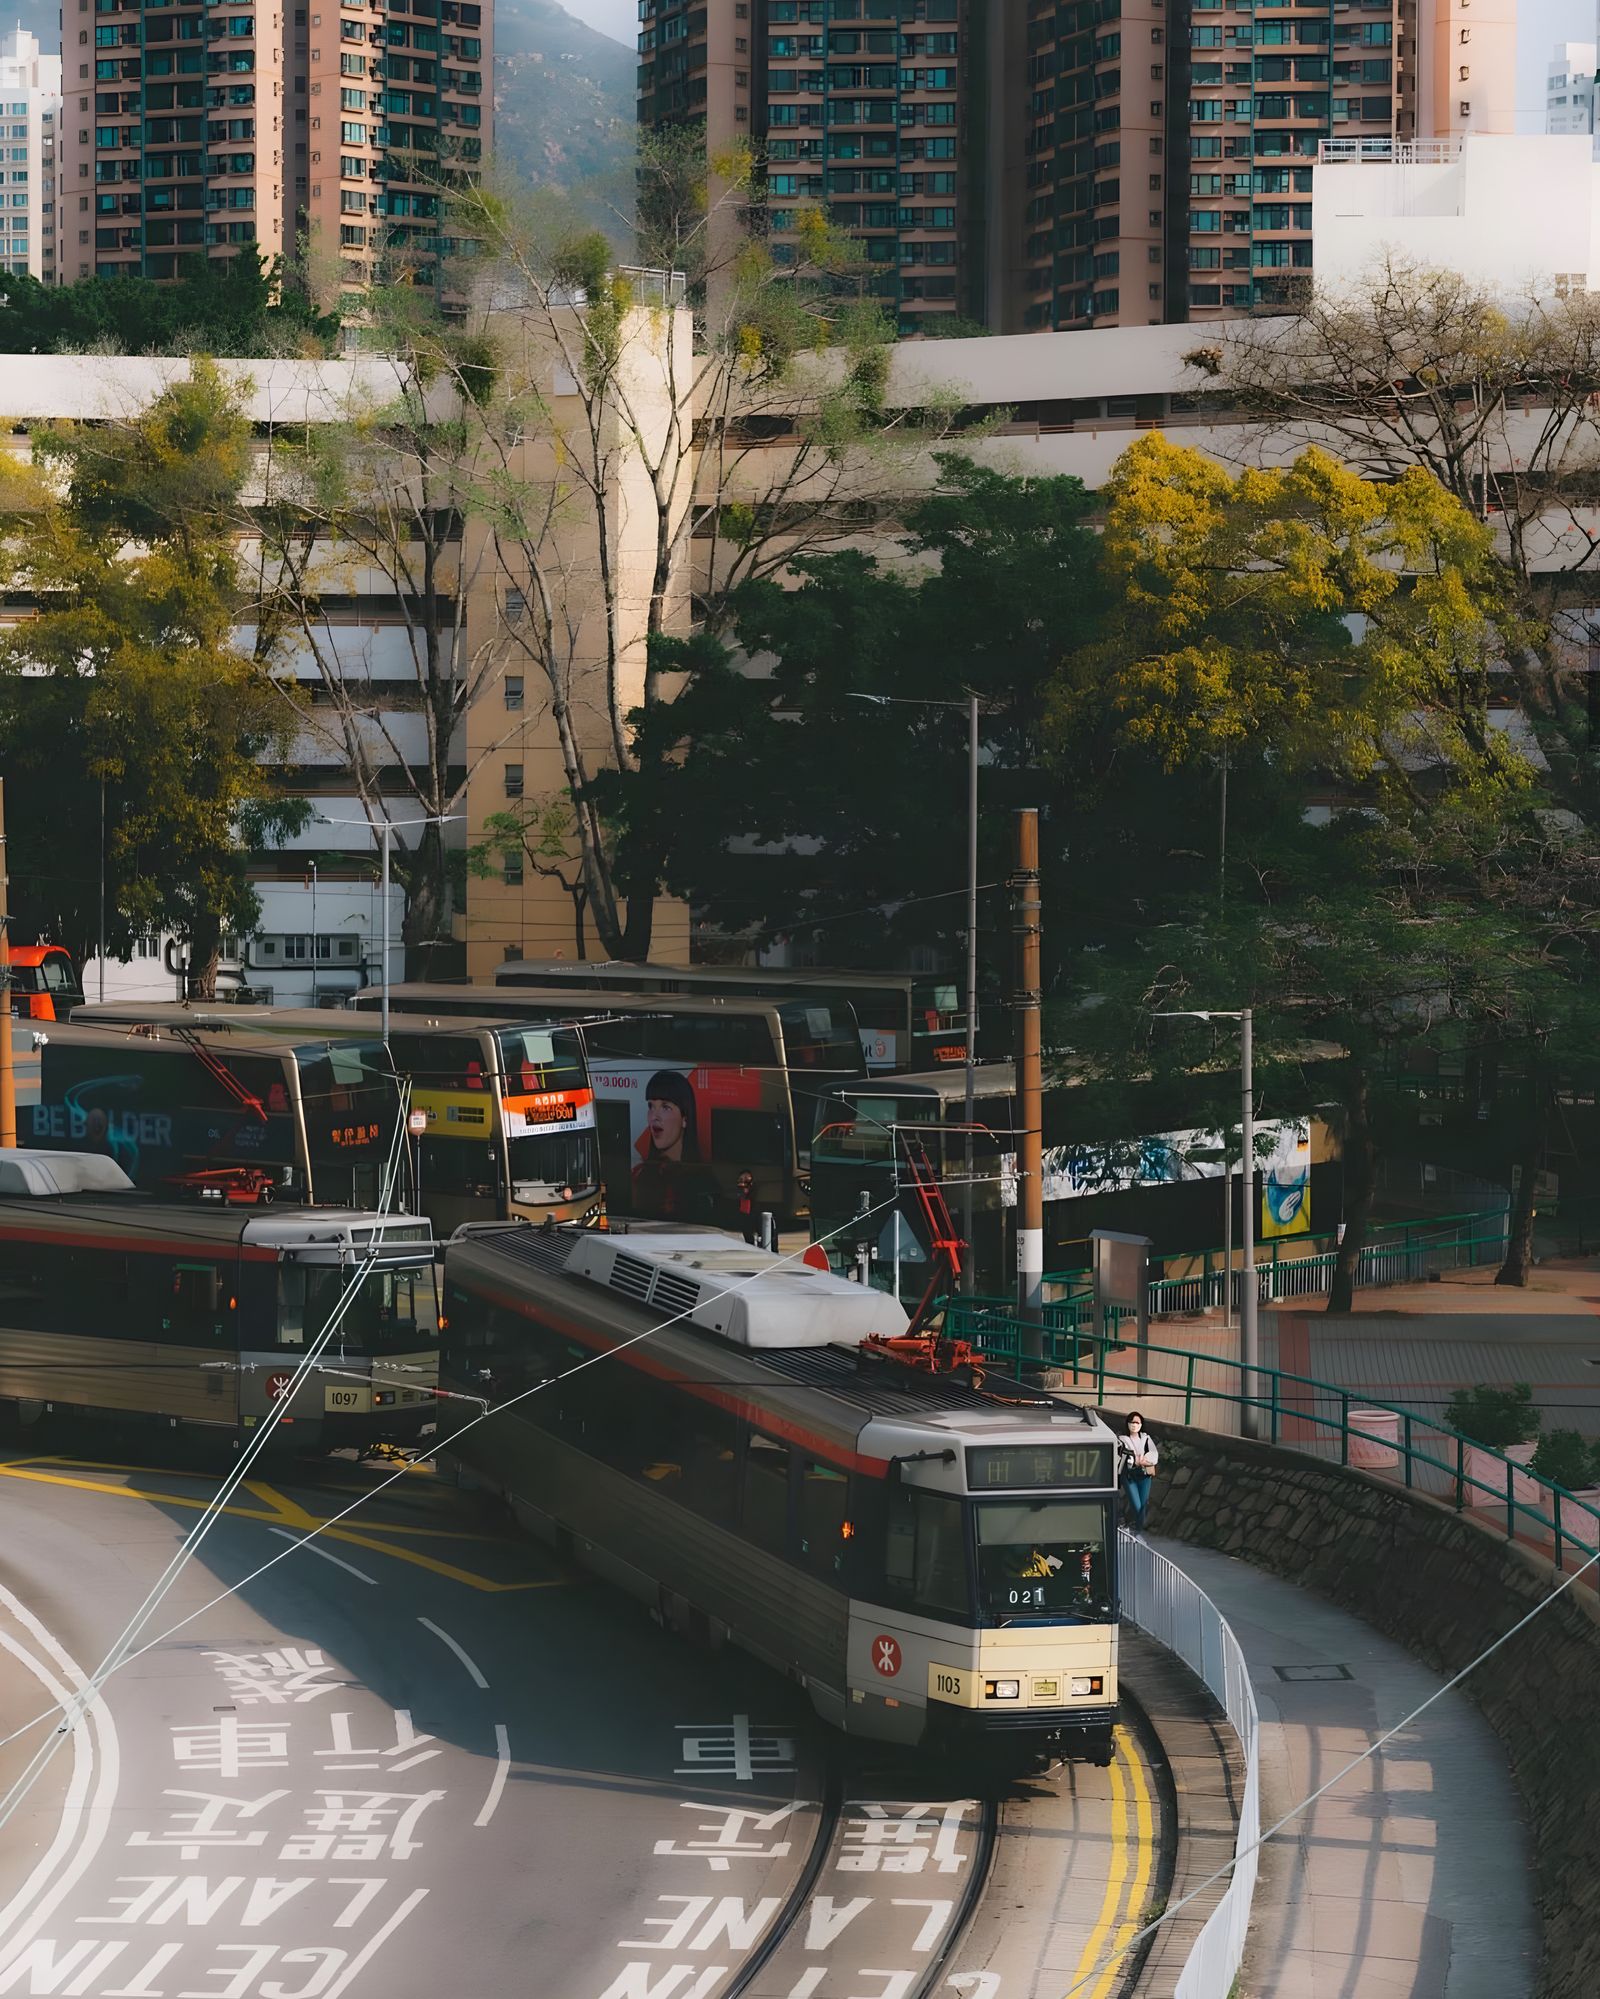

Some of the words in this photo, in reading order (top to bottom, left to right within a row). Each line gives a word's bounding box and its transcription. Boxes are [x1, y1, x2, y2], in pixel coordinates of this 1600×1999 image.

[32, 1104, 65, 1138] BE
[331, 1392, 358, 1406] 1097
[1063, 1450, 1100, 1478] 507
[1008, 1587, 1044, 1604] 021
[937, 1674, 961, 1695] 1103
[169, 1709, 443, 1778] 行車
[125, 1788, 449, 1860] 選定
[74, 1875, 388, 1928] LANE
[617, 1895, 953, 1952] LANE
[0, 1938, 131, 1998] IN
[99, 1942, 349, 1999] GET
